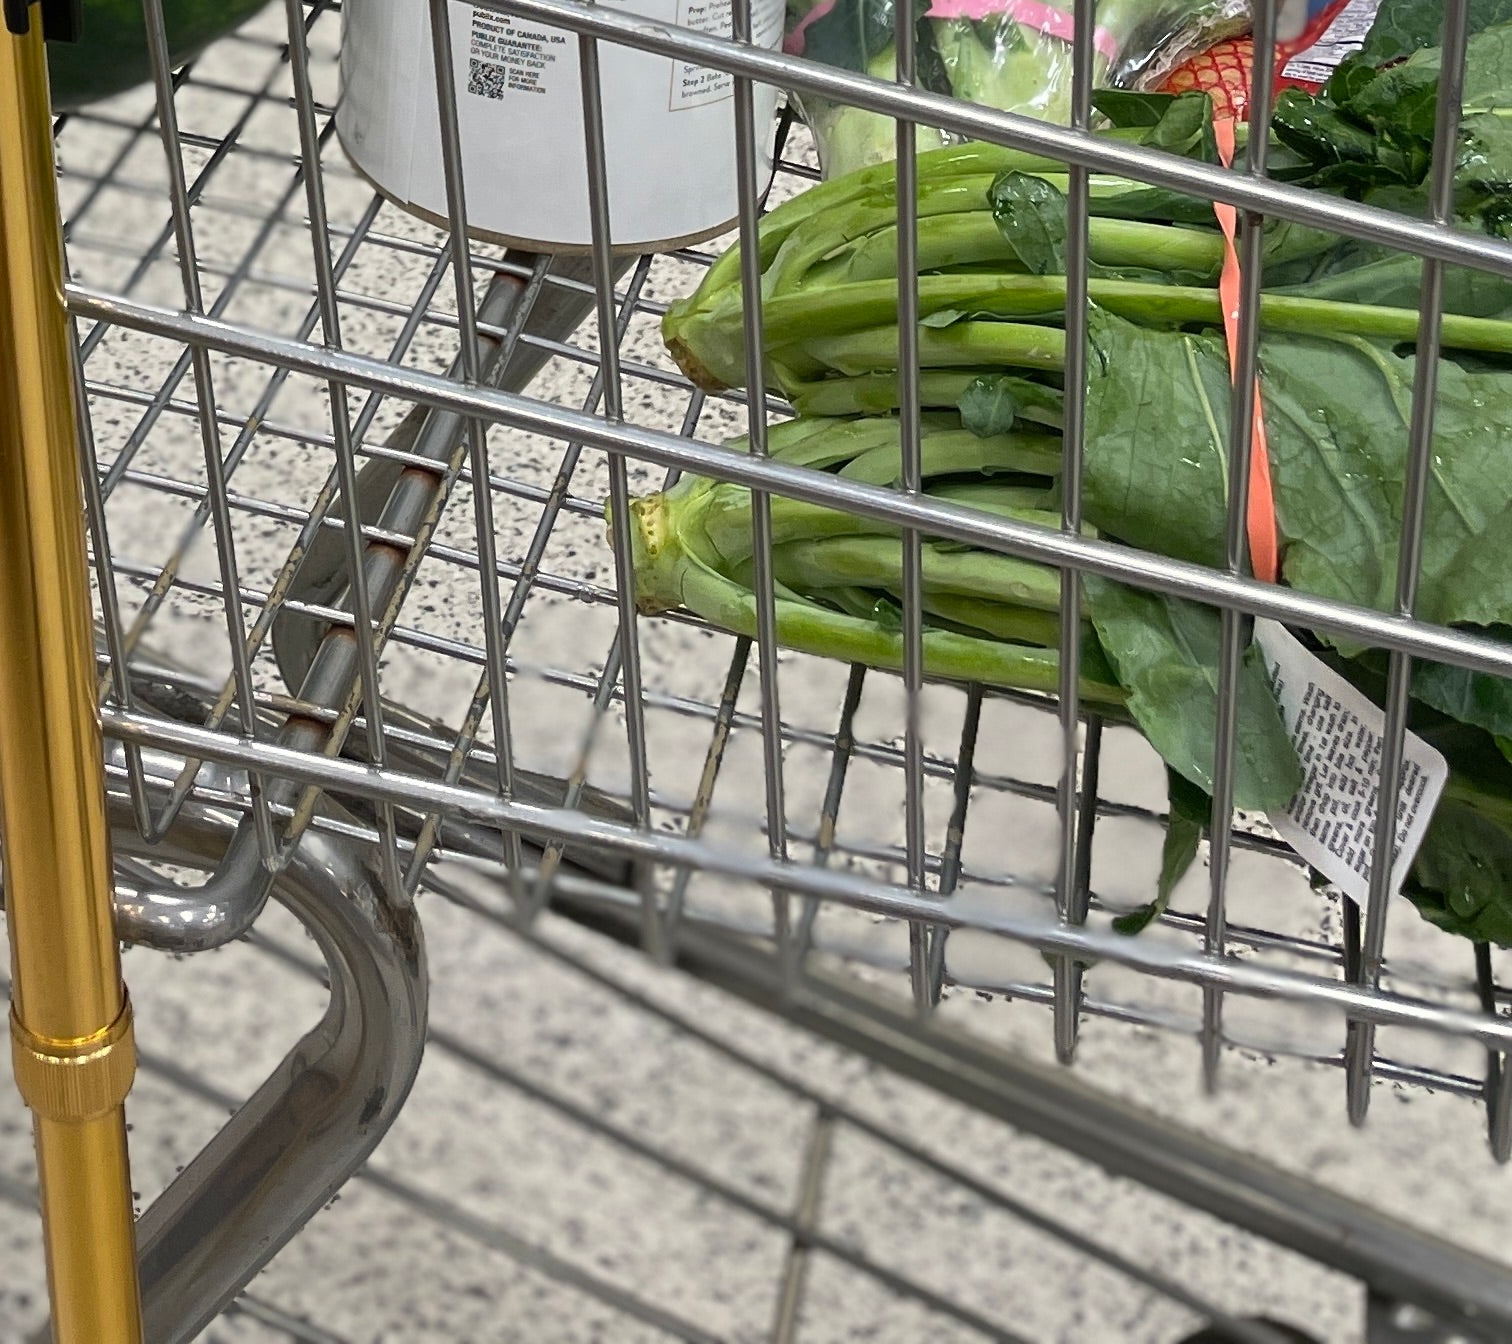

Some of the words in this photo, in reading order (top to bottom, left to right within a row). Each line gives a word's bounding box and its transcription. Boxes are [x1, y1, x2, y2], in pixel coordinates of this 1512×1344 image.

[472, 20, 504, 34] PRODUCT
[517, 31, 548, 43] CANADA,
[551, 36, 566, 44] USA
[472, 31, 495, 42] PUBLIX
[498, 37, 542, 51] GUARANTEE:
[471, 39, 506, 54] COMPLETE
[508, 47, 555, 61] SATISFACTION
[481, 50, 498, 60] YOUR
[501, 55, 524, 65] MONEY
